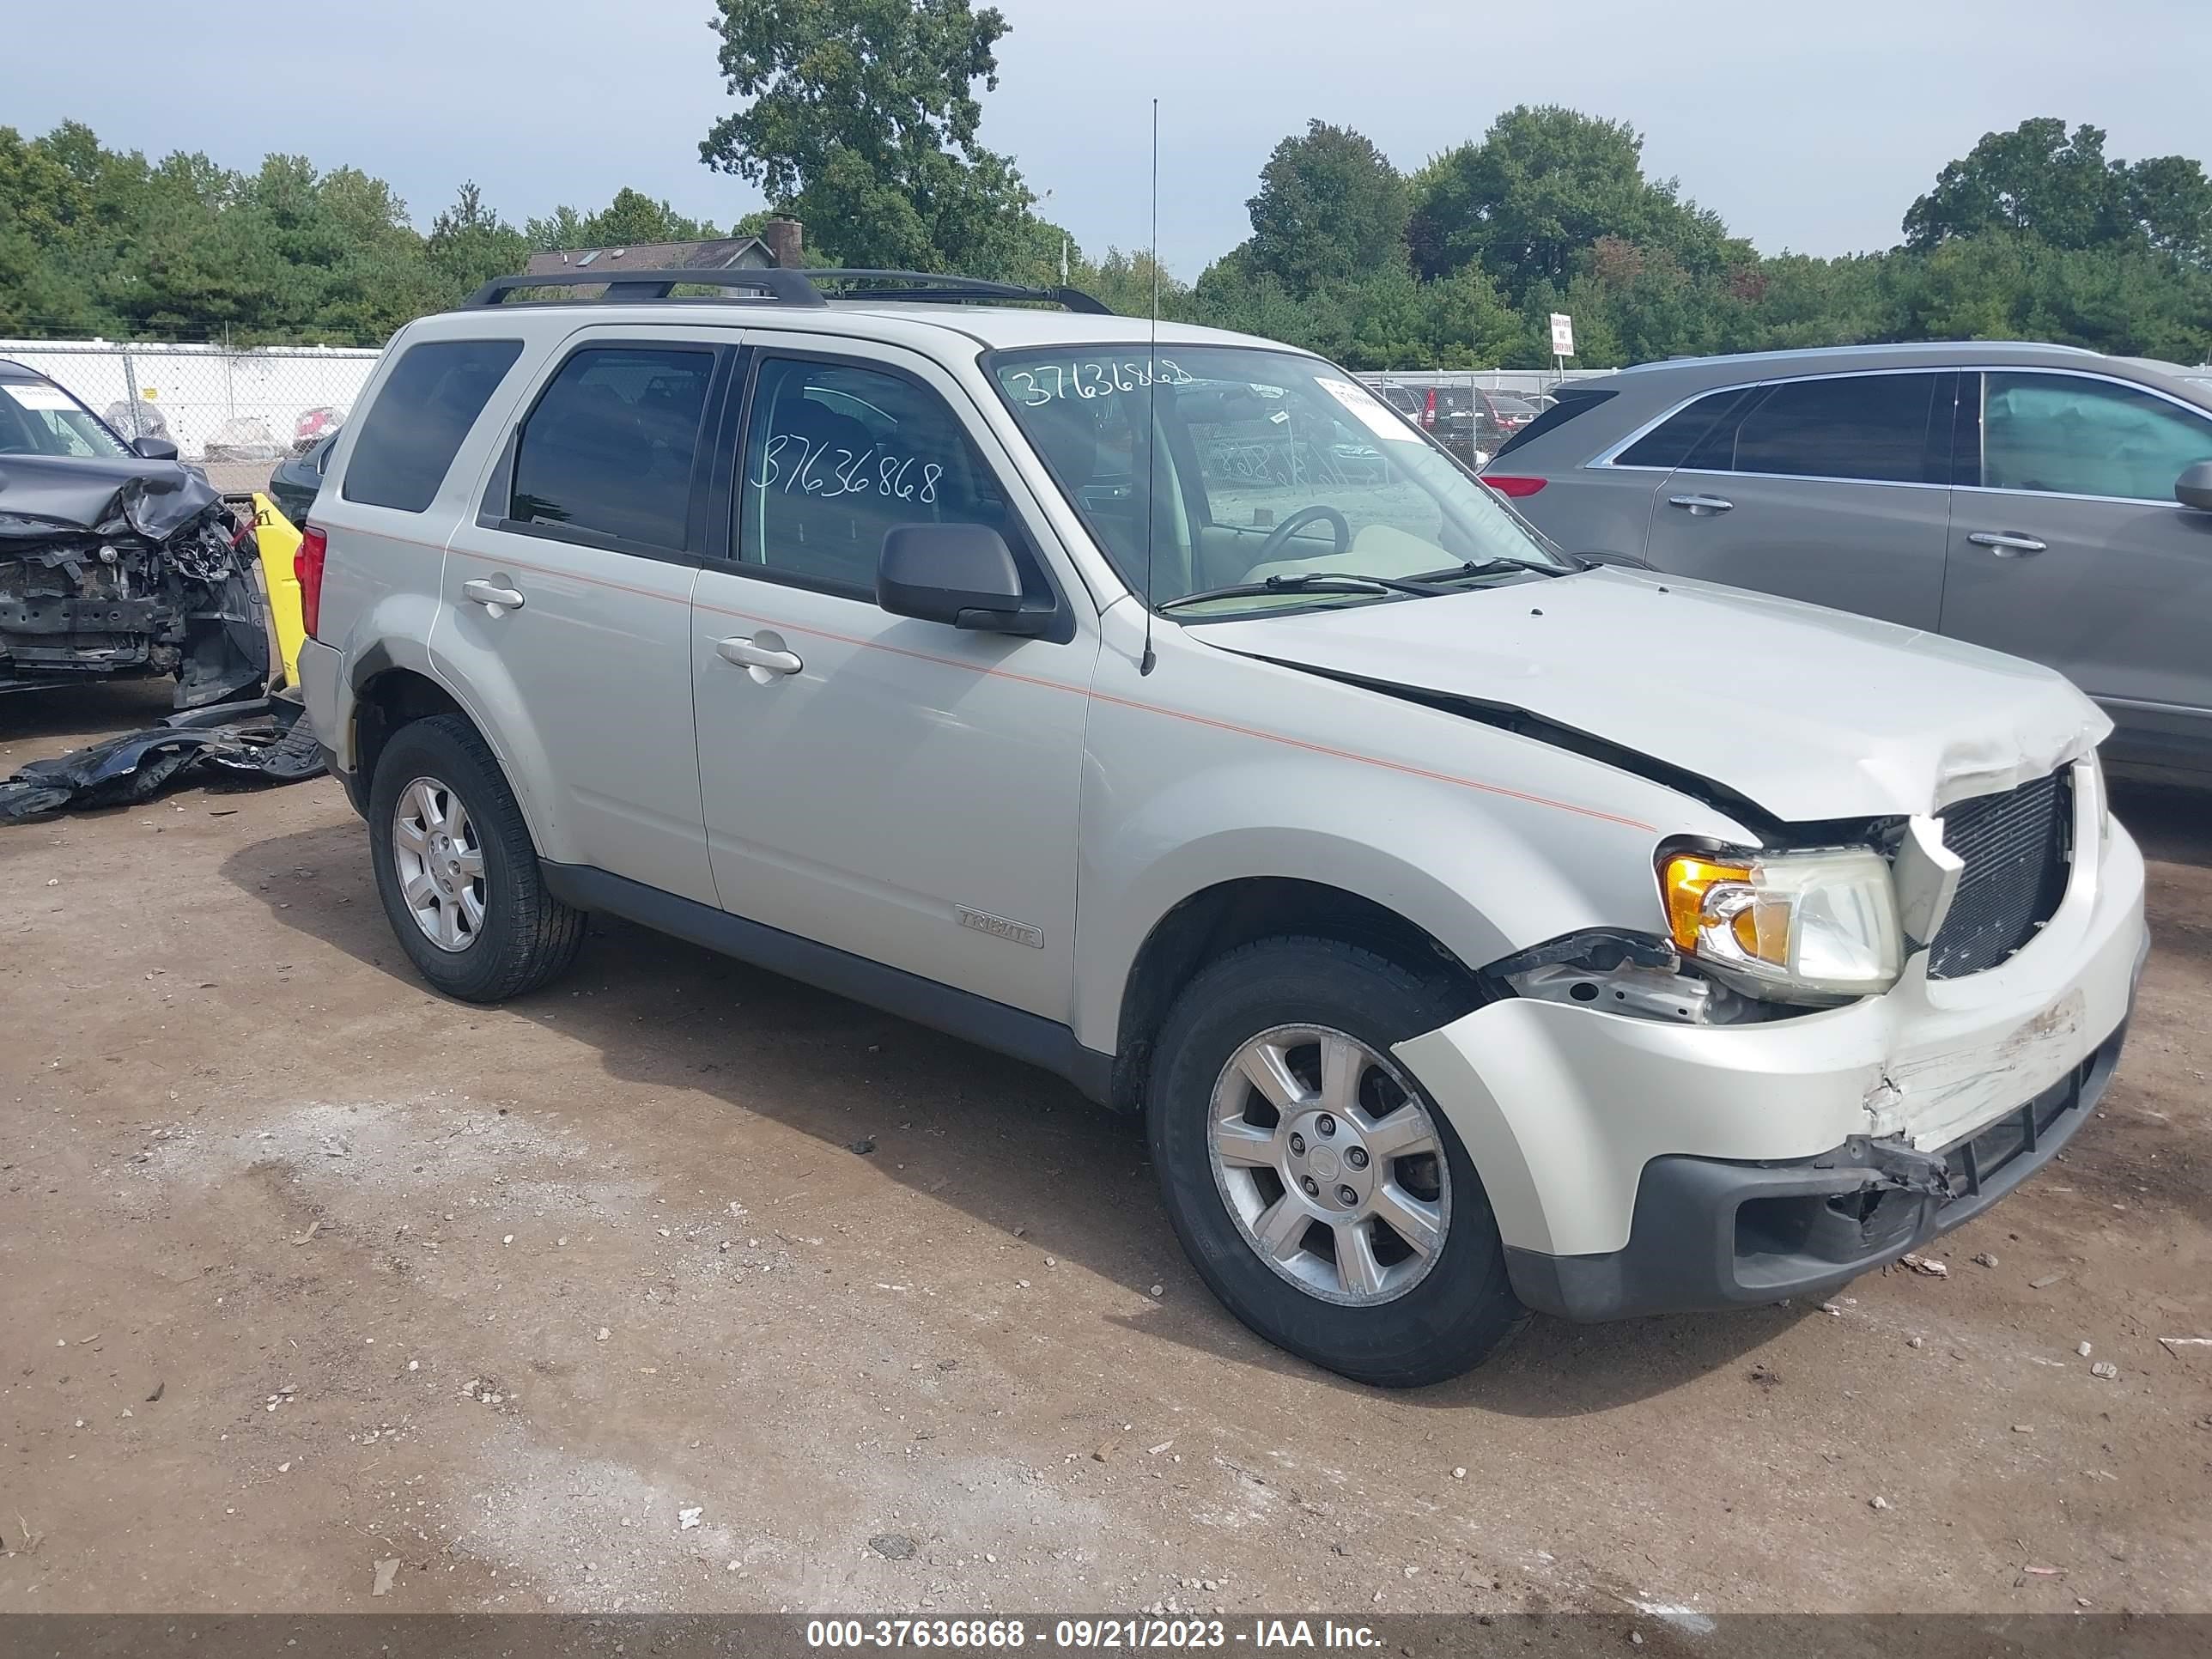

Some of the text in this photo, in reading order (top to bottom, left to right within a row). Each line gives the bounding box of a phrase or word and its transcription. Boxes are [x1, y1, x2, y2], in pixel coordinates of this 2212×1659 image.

[1012, 359, 1193, 407] 37636868
[750, 433, 944, 504] 37636868
[958, 908, 1036, 945] TRIBUTE
